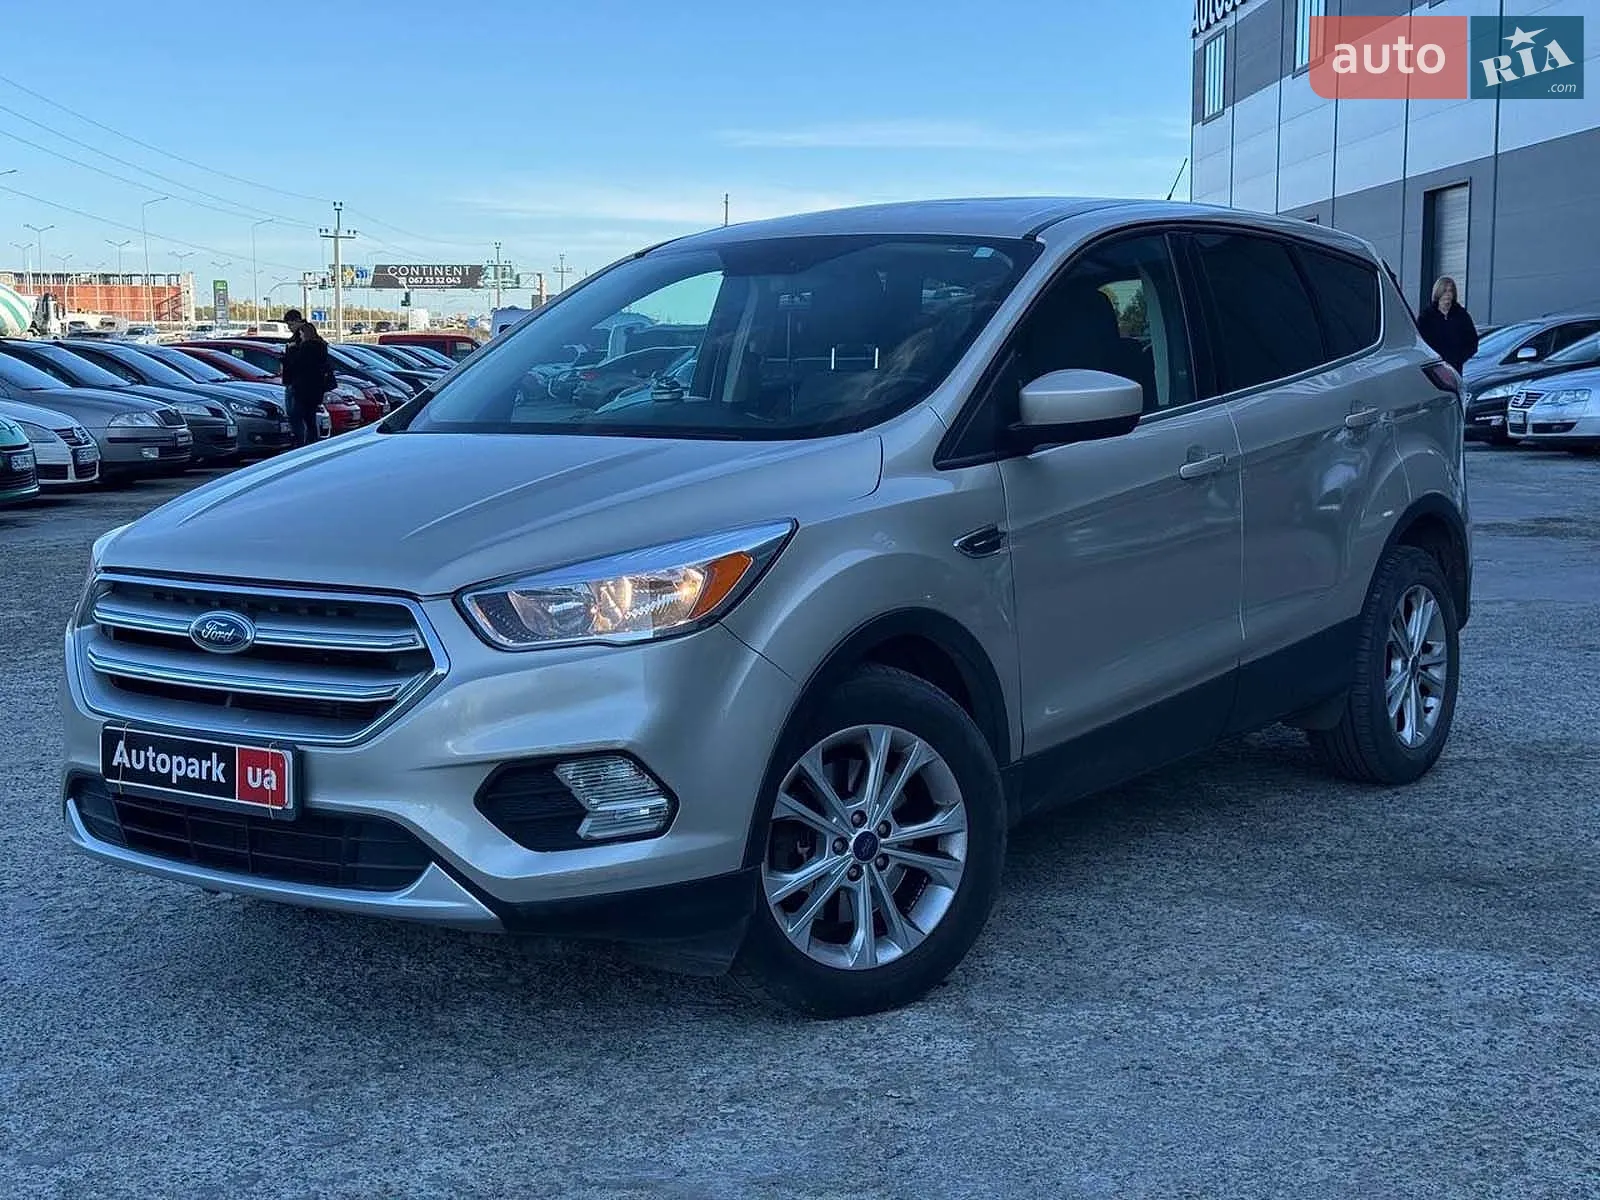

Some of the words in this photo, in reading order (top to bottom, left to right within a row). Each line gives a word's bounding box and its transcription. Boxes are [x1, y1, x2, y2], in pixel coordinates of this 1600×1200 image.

[1191, 0, 1242, 38] Auto
[387, 265, 471, 276] CONTINENT
[408, 276, 424, 284] 067
[201, 619, 236, 642] Ford
[112, 740, 227, 783] Autopark
[247, 766, 278, 791] ua
